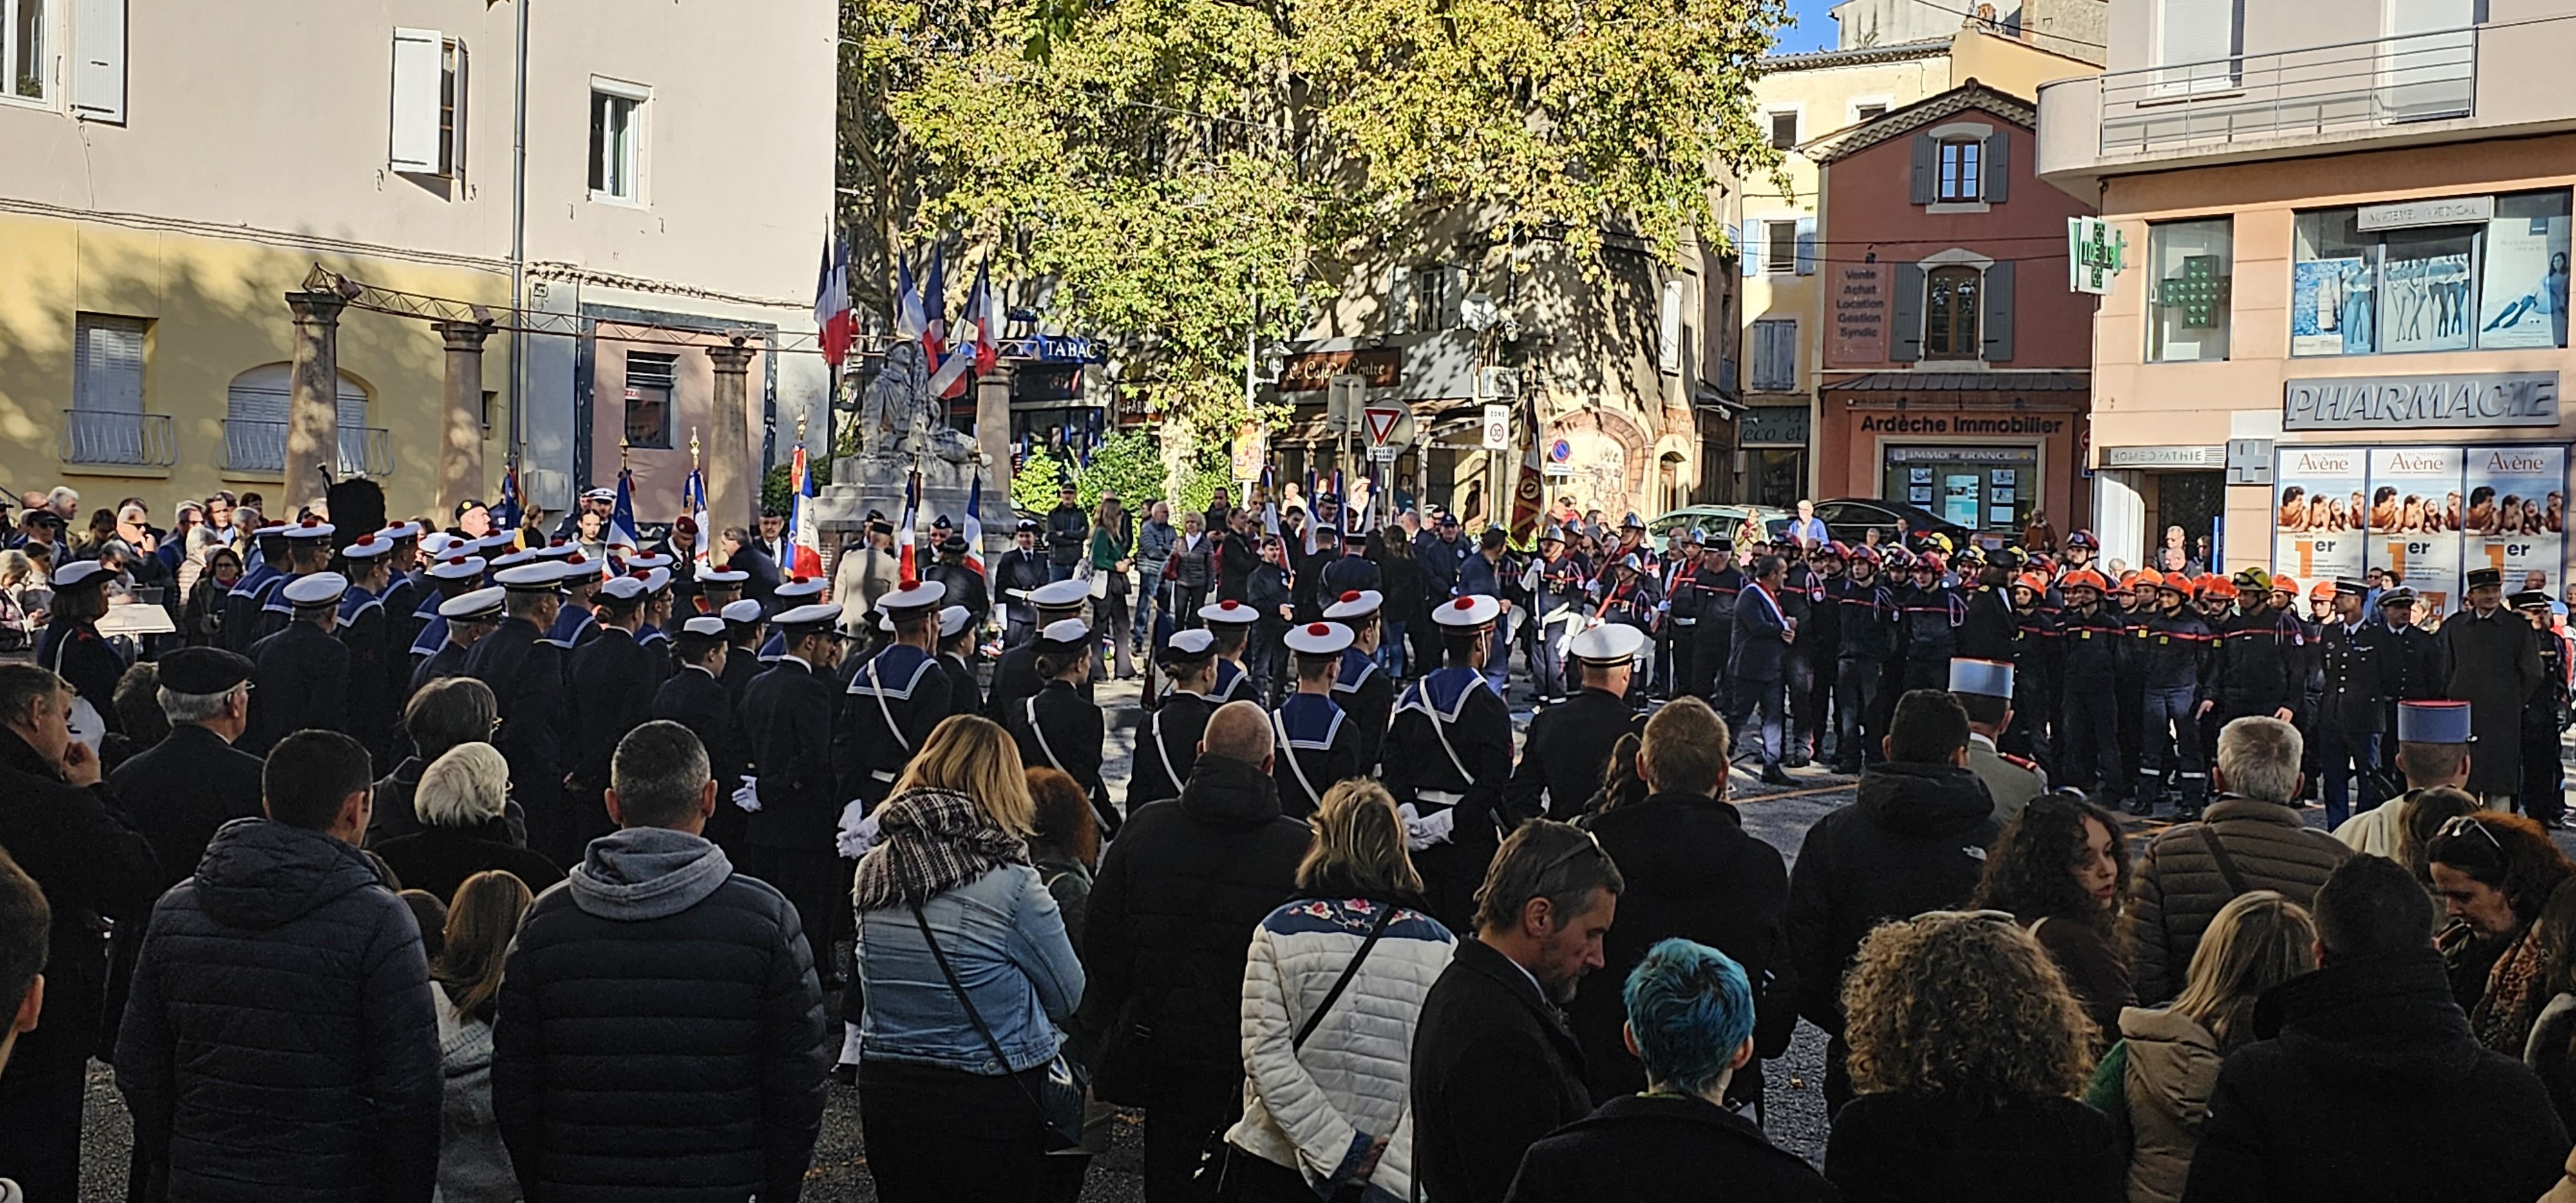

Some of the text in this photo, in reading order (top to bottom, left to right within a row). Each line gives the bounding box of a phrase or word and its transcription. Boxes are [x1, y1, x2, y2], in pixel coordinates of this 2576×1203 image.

[1845, 270, 1876, 279] Vente
[1844, 285, 1876, 294] Achat
[1837, 299, 1884, 308] Location
[1838, 313, 1881, 322] Gestion
[1840, 327, 1878, 339] Syndic
[1045, 340, 1098, 359] TABAC
[1286, 362, 1302, 380] Le
[2286, 379, 2555, 422] PHARMACIE
[1861, 415, 2063, 433] Ardèche Immobilier
[1493, 428, 1501, 437] 30
[1910, 451, 1947, 460] IMMO
[1961, 451, 2012, 460] FRANCE
[2297, 453, 2349, 470] Avène
[2390, 452, 2443, 470] Avène
[2486, 451, 2544, 470] Avène
